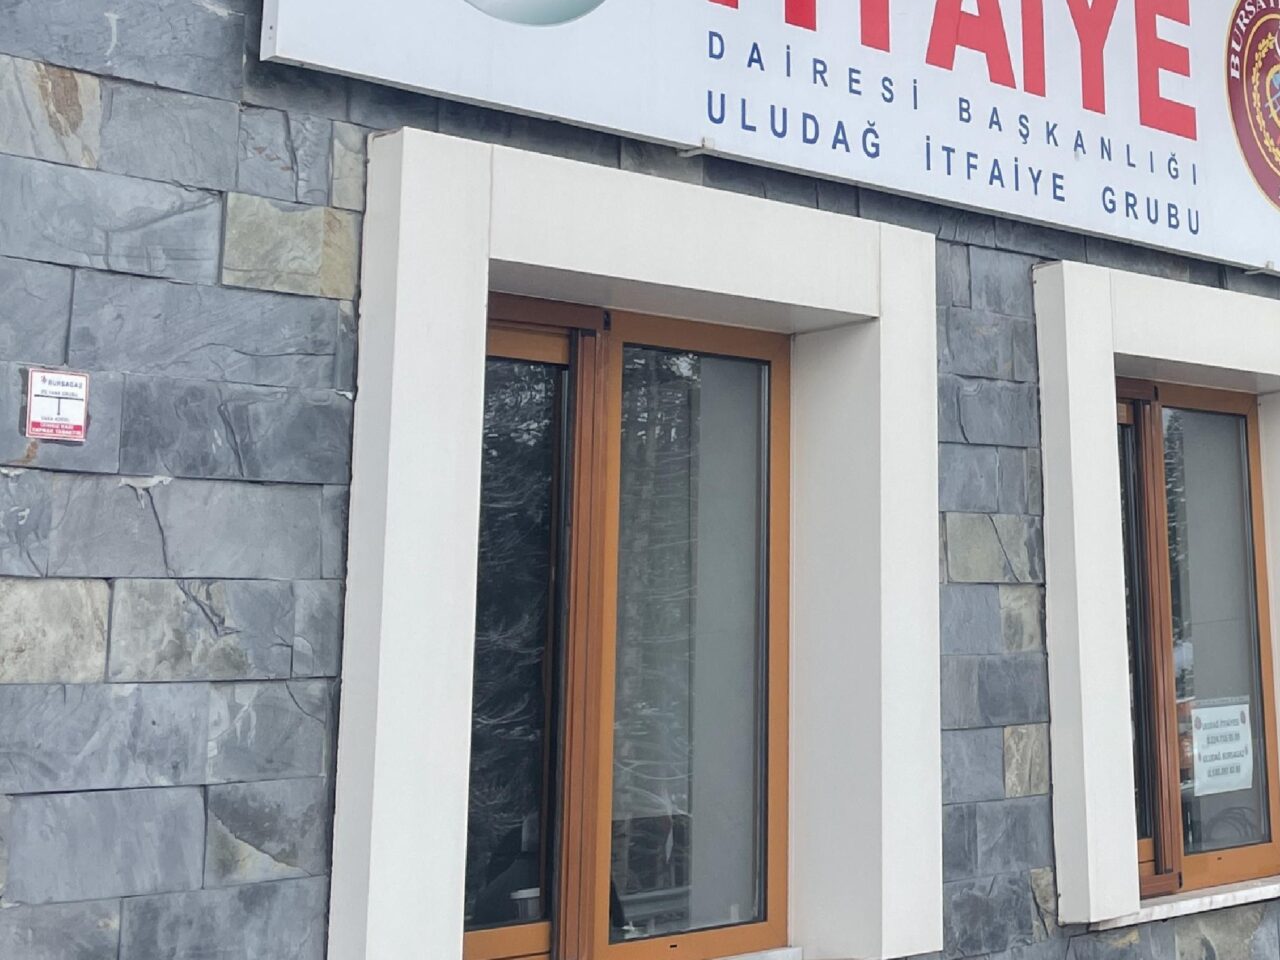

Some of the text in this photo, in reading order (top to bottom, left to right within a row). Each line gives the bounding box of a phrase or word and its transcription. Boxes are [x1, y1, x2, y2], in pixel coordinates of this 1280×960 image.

[706, 90, 1201, 236] ULUDAĞ İTFAİYE GRUBU
[707, 30, 1198, 186] DAİRESİ BAŞKANLIĞI
